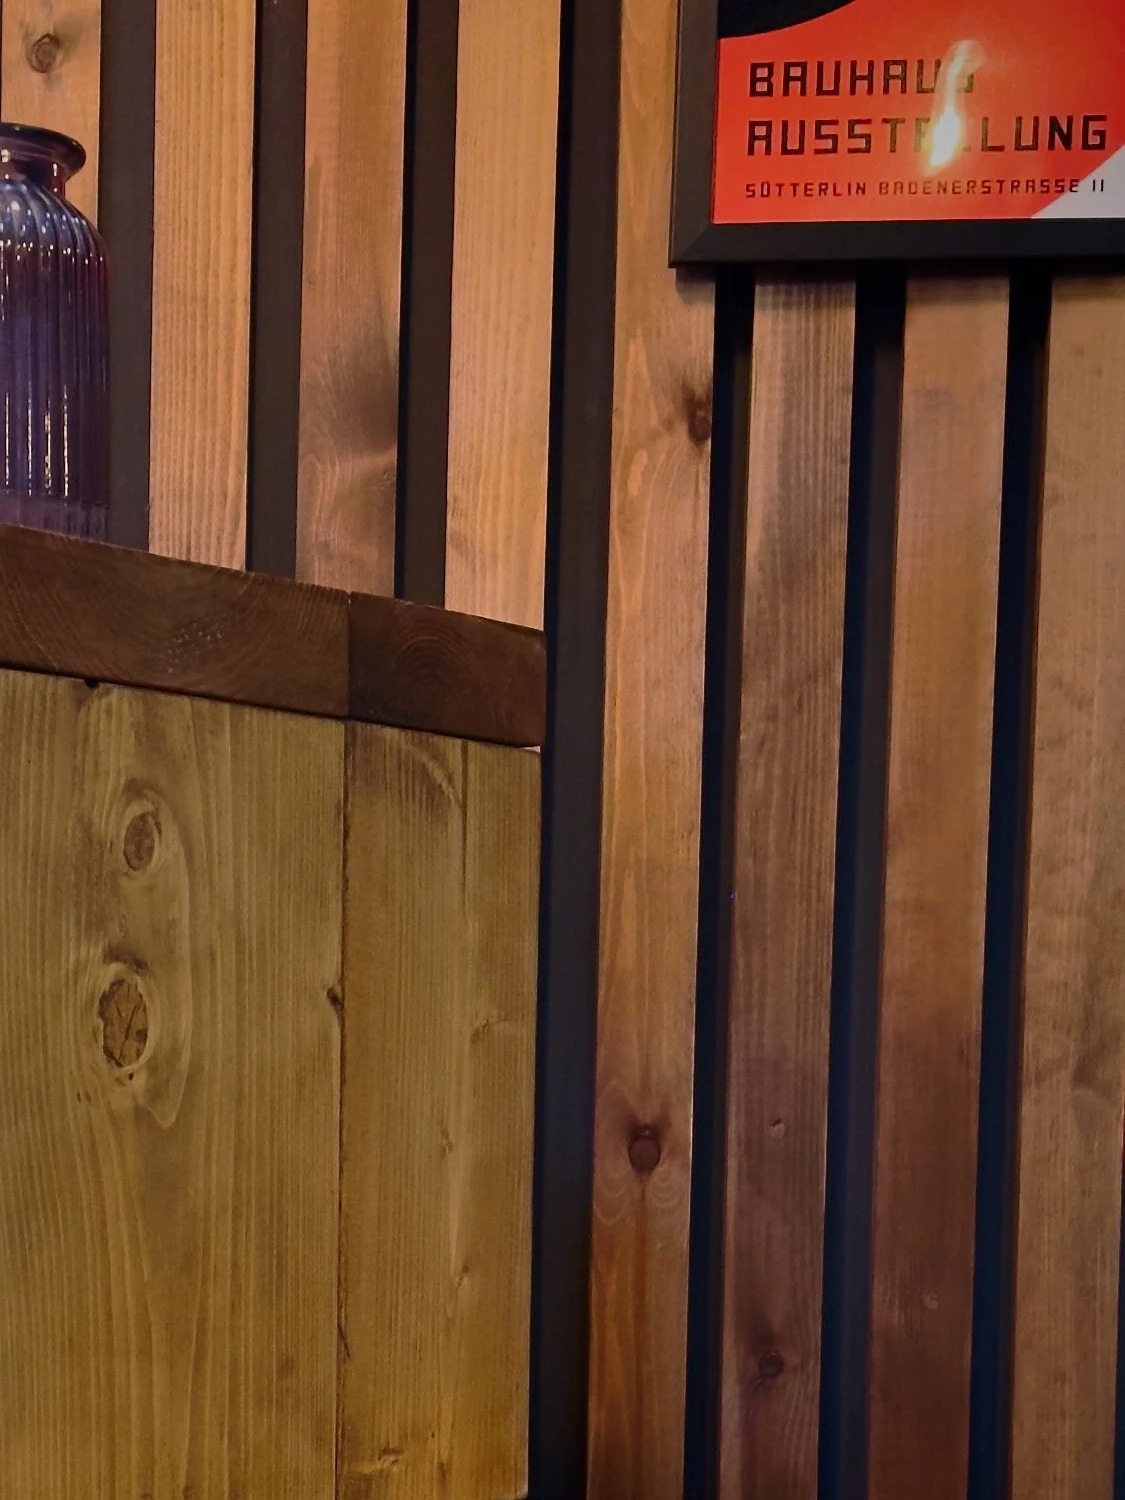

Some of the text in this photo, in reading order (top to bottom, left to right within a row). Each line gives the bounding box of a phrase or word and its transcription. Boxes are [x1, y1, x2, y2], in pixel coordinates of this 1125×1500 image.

[747, 113, 1108, 156] AUSSTELUNG
[745, 180, 868, 199] SÜTTERLIN
[879, 177, 1080, 197] BADENERSTRASSE
